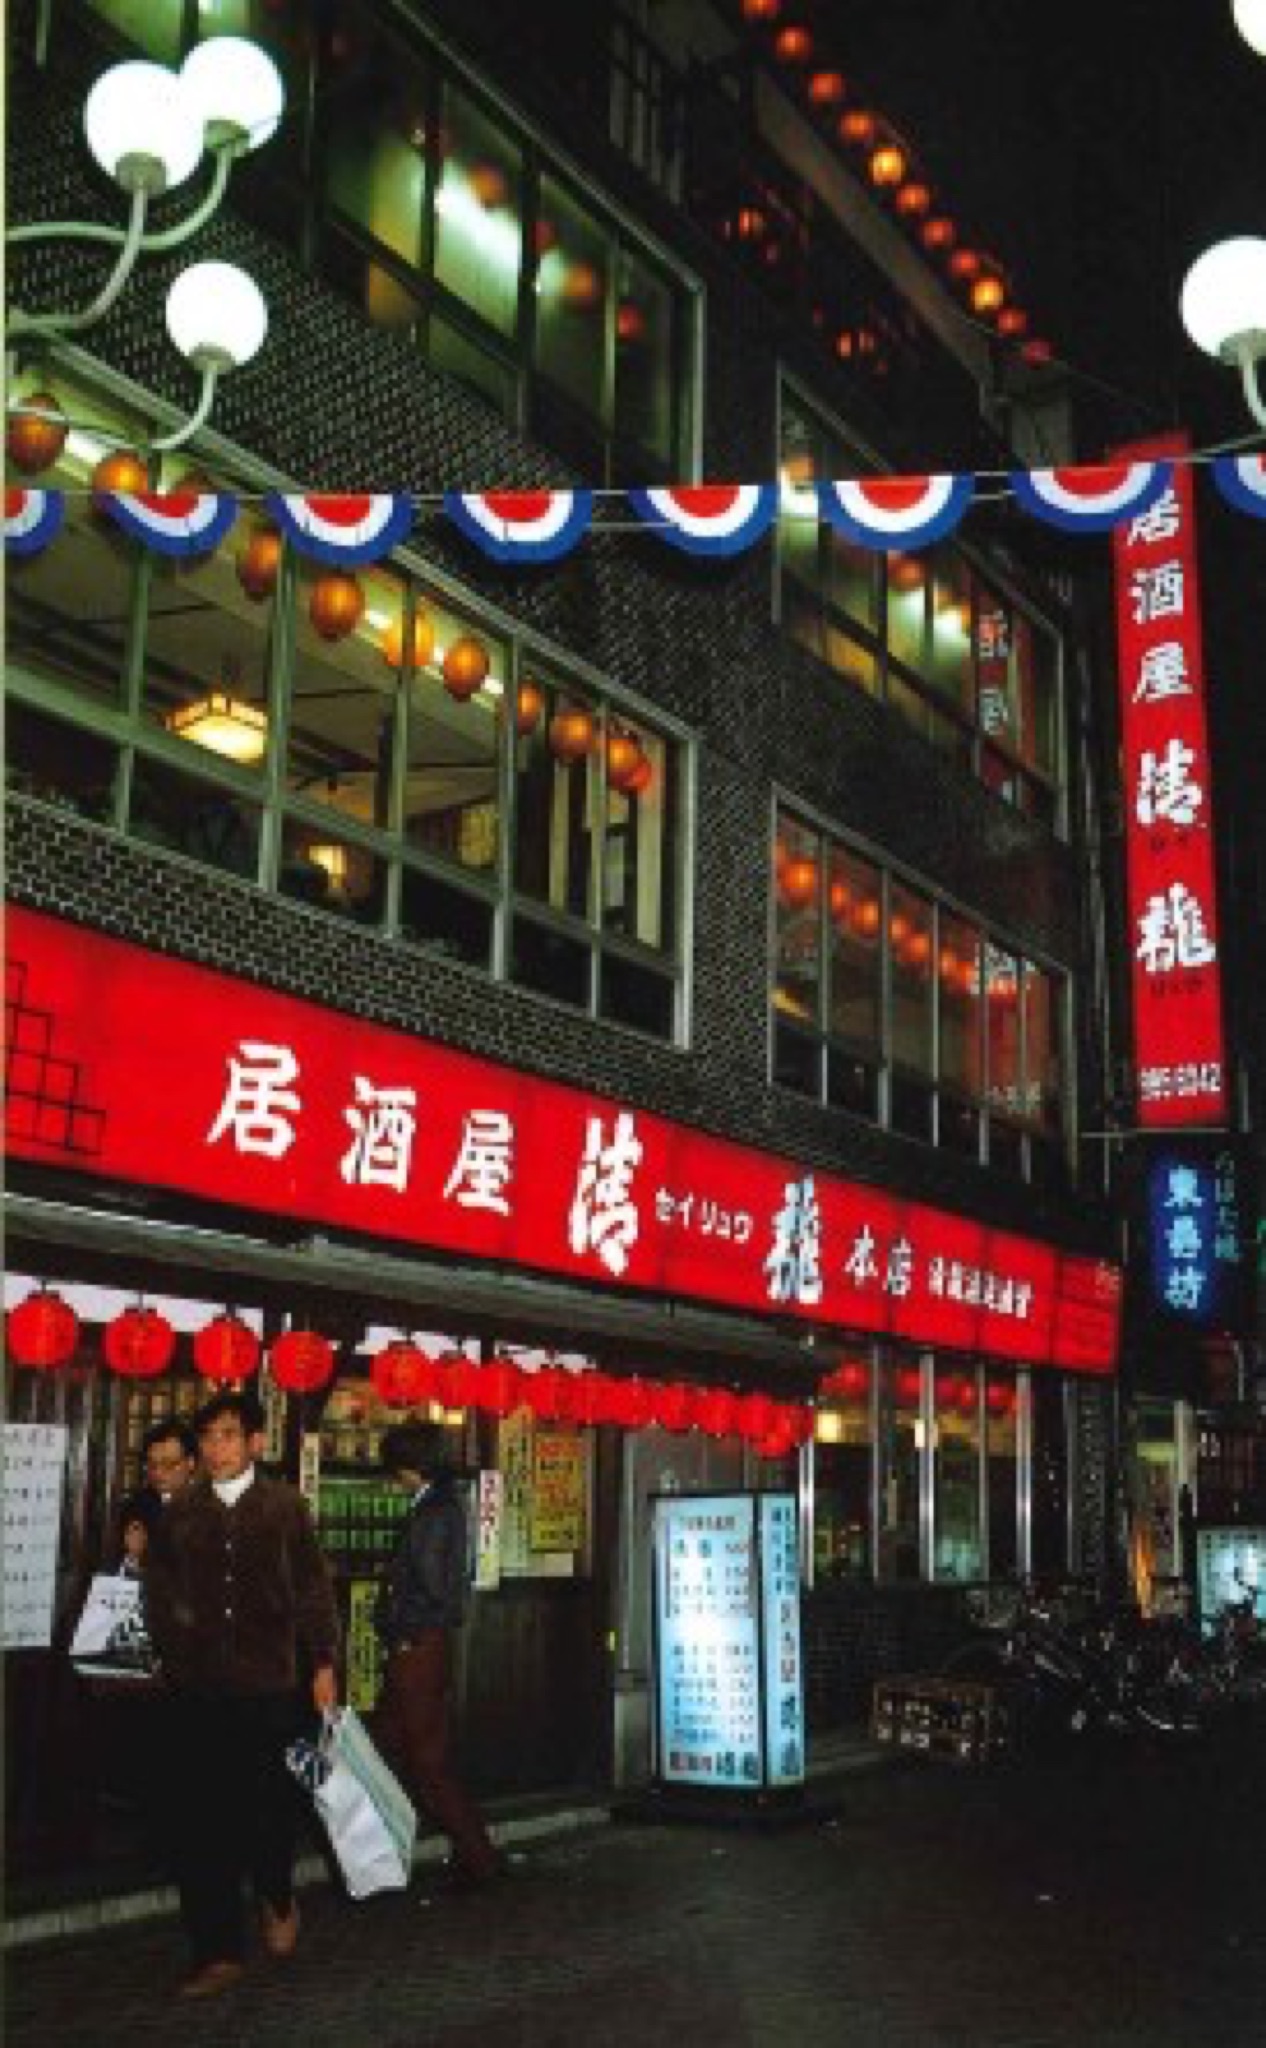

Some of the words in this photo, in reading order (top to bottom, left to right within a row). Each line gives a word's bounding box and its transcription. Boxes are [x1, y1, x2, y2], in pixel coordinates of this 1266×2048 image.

[206, 1040, 514, 1217] 居酒屋
[844, 1224, 912, 1296] 本店
